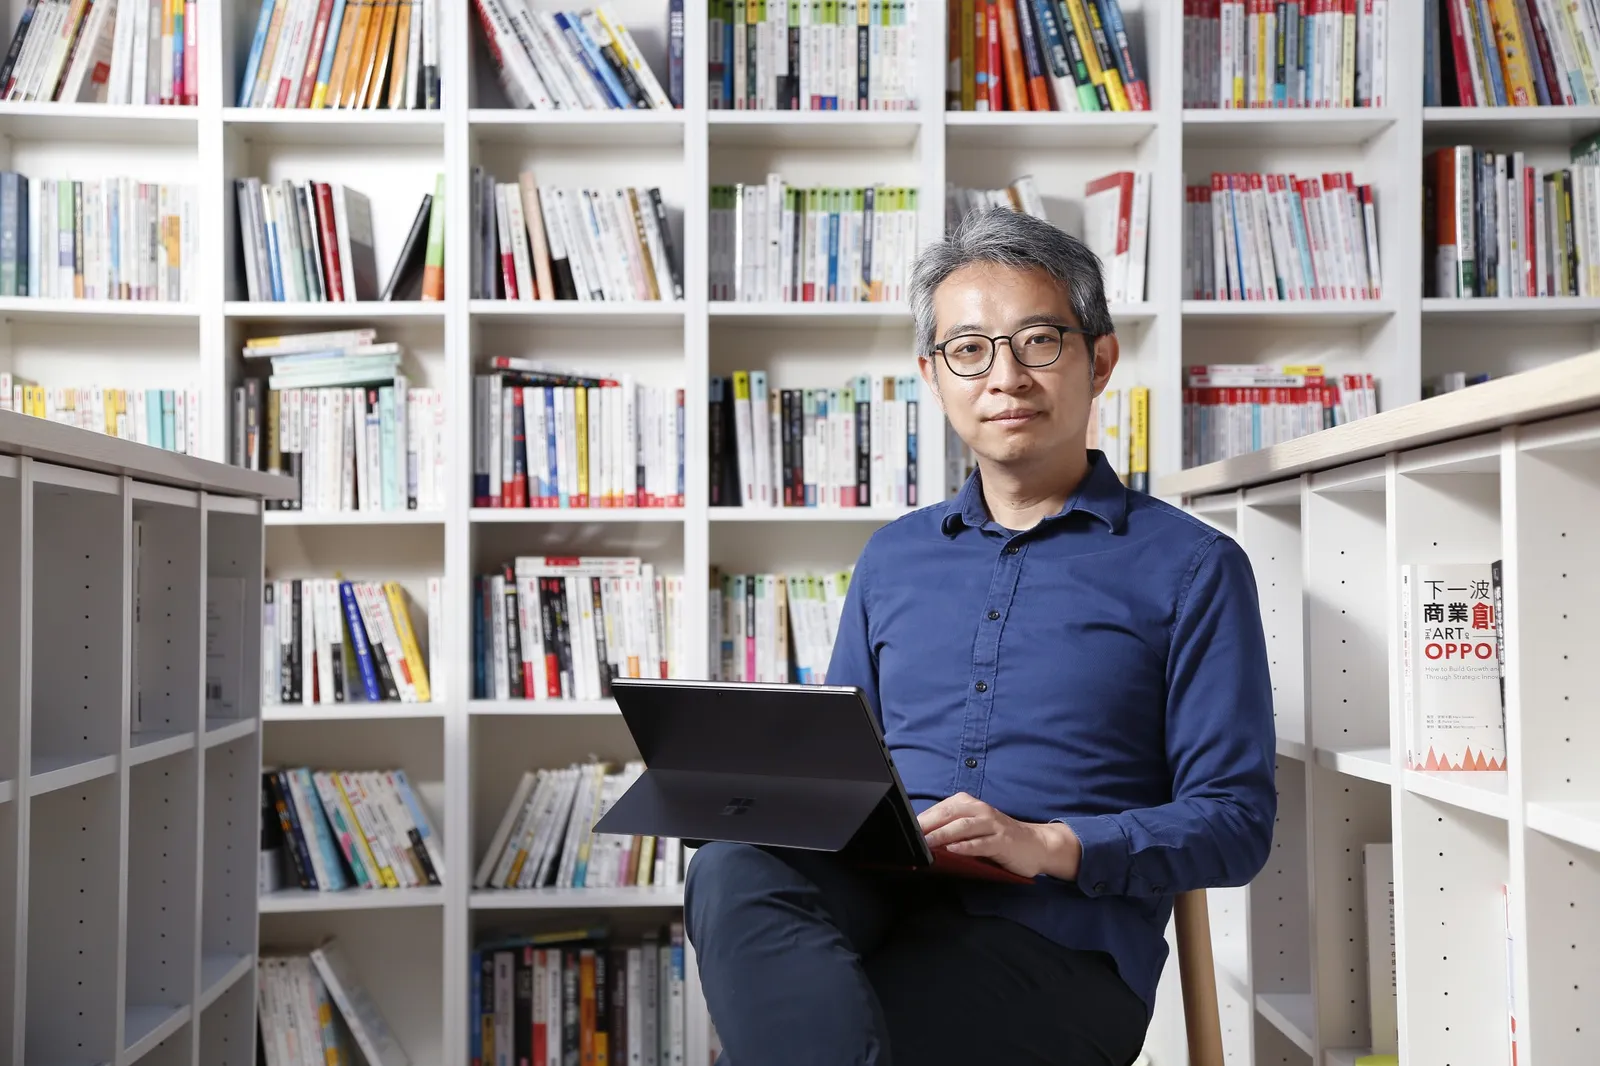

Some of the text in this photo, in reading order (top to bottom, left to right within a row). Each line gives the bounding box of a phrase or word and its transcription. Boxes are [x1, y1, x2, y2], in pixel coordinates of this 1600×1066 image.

[1424, 580, 1490, 600] 下一波
[1424, 602, 1497, 630] 商業創
[1432, 628, 1464, 640] ART
